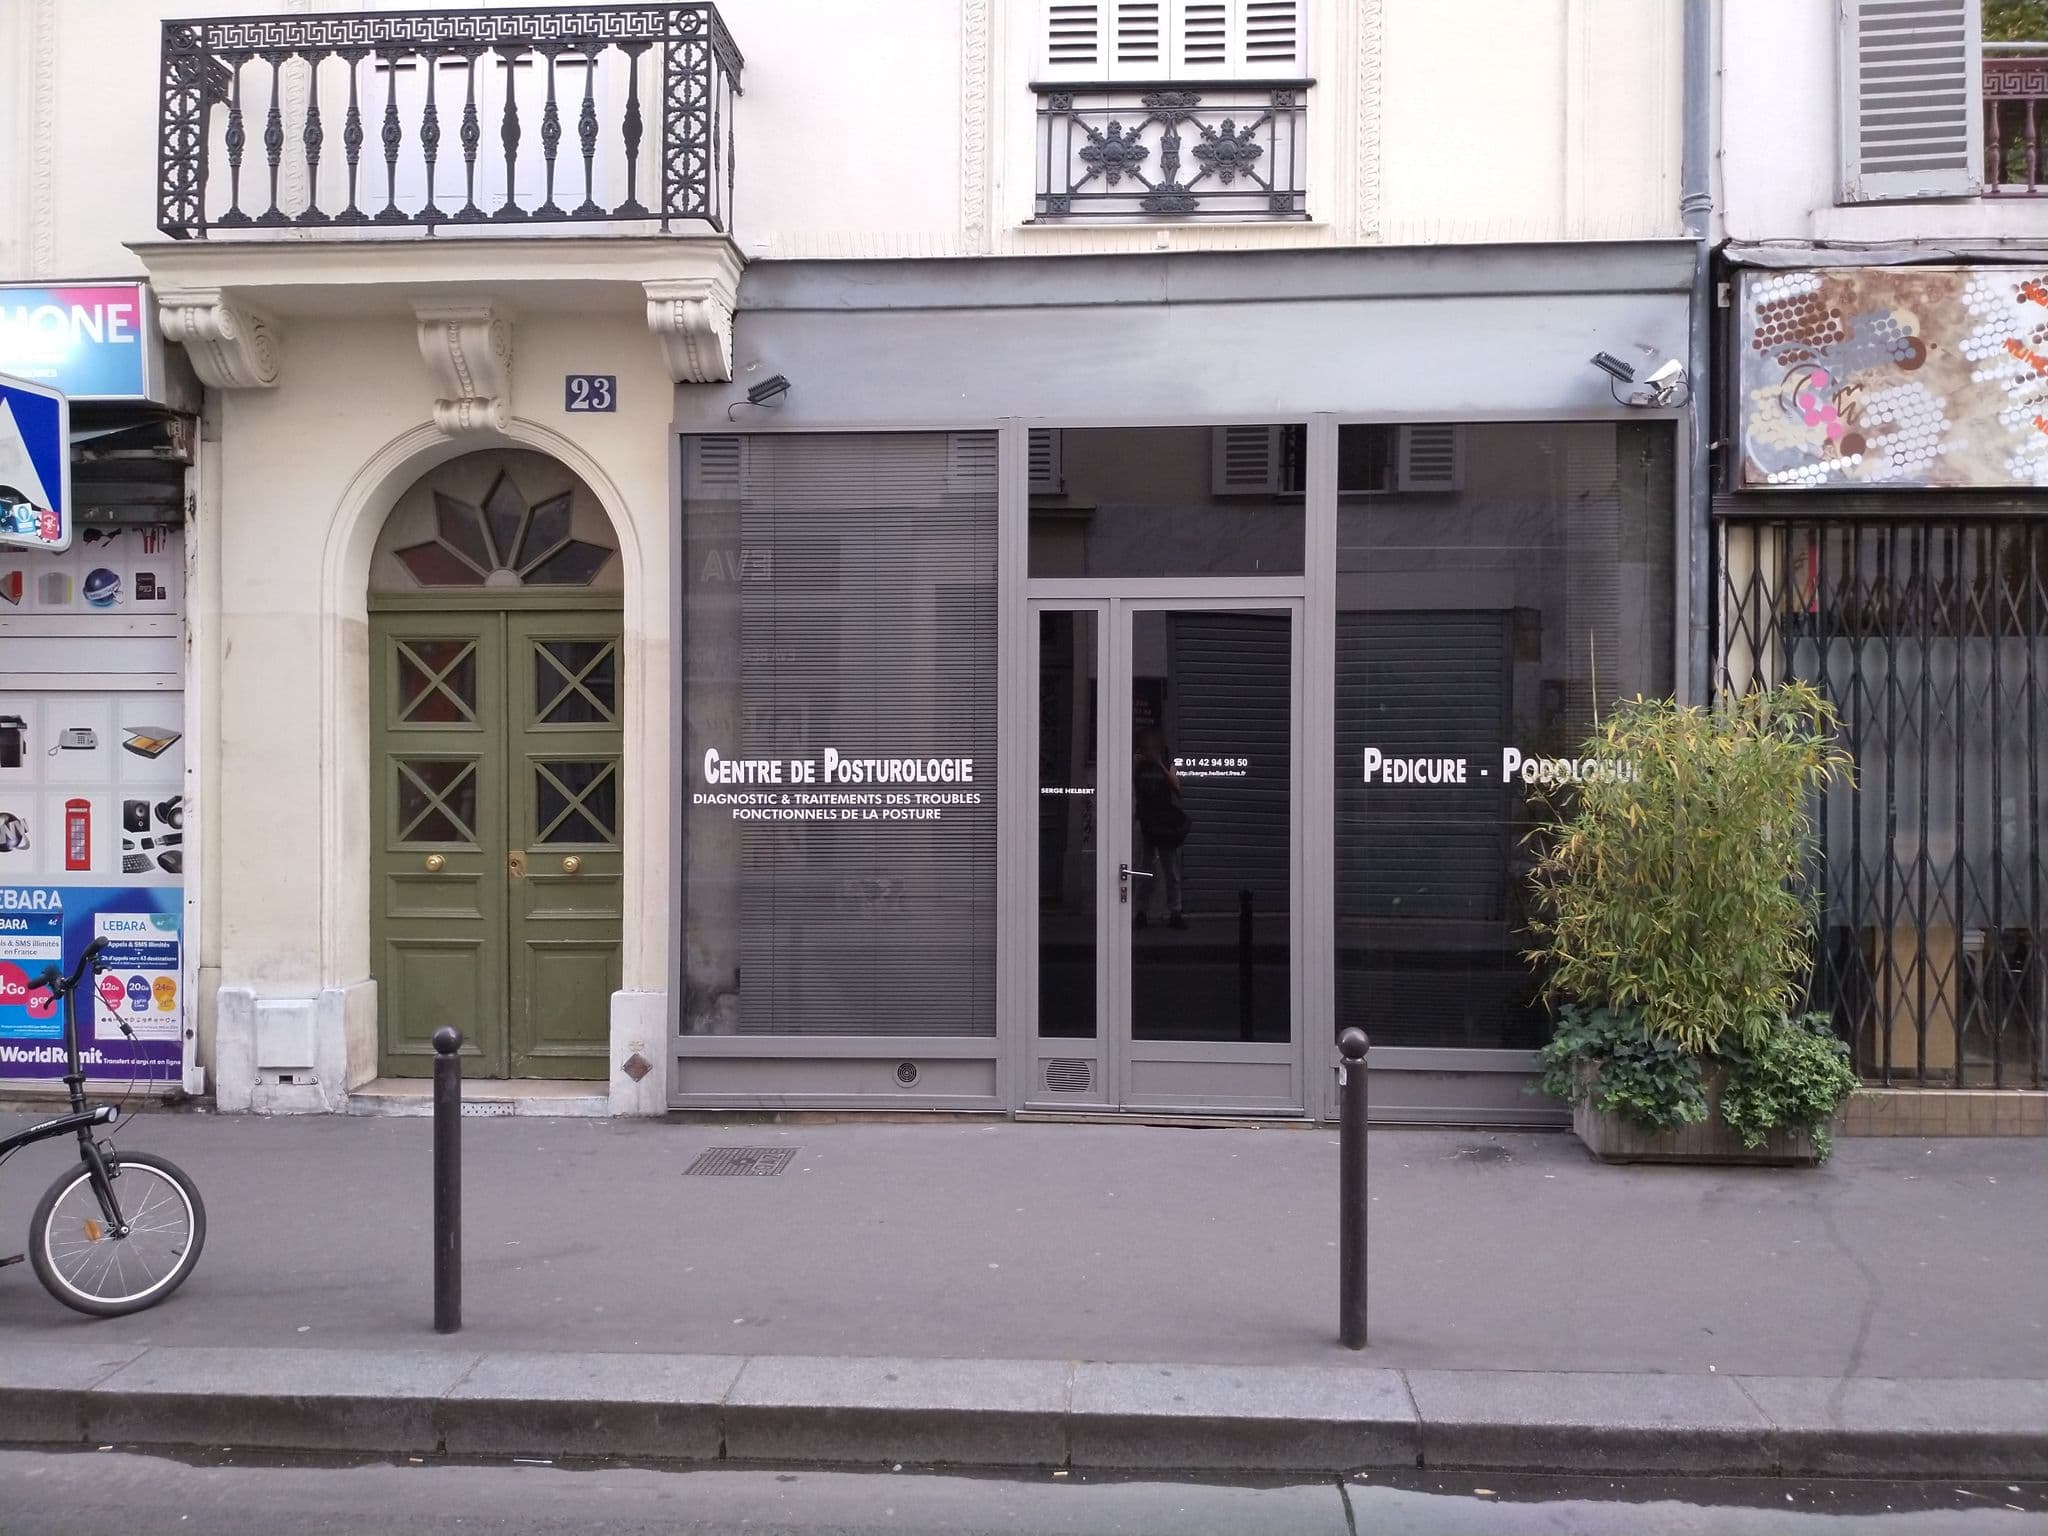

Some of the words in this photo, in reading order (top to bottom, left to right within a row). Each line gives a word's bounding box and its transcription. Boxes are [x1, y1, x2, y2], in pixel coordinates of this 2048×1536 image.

[571, 378, 611, 409] 23
[704, 747, 782, 785] CENTRE
[791, 759, 816, 784] DE
[824, 747, 973, 784] POSTUROLOGIE
[1185, 758, 1196, 767] 01
[1198, 758, 1210, 767] 42
[1211, 758, 1223, 767] 94
[1224, 758, 1236, 767] 98
[1237, 758, 1248, 767] 50
[1363, 747, 1467, 784] PEDICURE
[1064, 787, 1096, 795] HELBERT
[693, 793, 777, 805] DIAGNOSTIC
[781, 793, 791, 805] &
[794, 793, 883, 805] TRAITEMENTS
[886, 793, 912, 805] DES
[914, 793, 981, 805] TROUBLES
[732, 808, 837, 820] FONCTIONNELS
[841, 808, 859, 820] DE
[862, 808, 879, 820] LA
[882, 808, 942, 820] POSTURE
[102, 920, 147, 932] LEBARA
[15, 939, 31, 947] SMS
[14, 948, 38, 956] France
